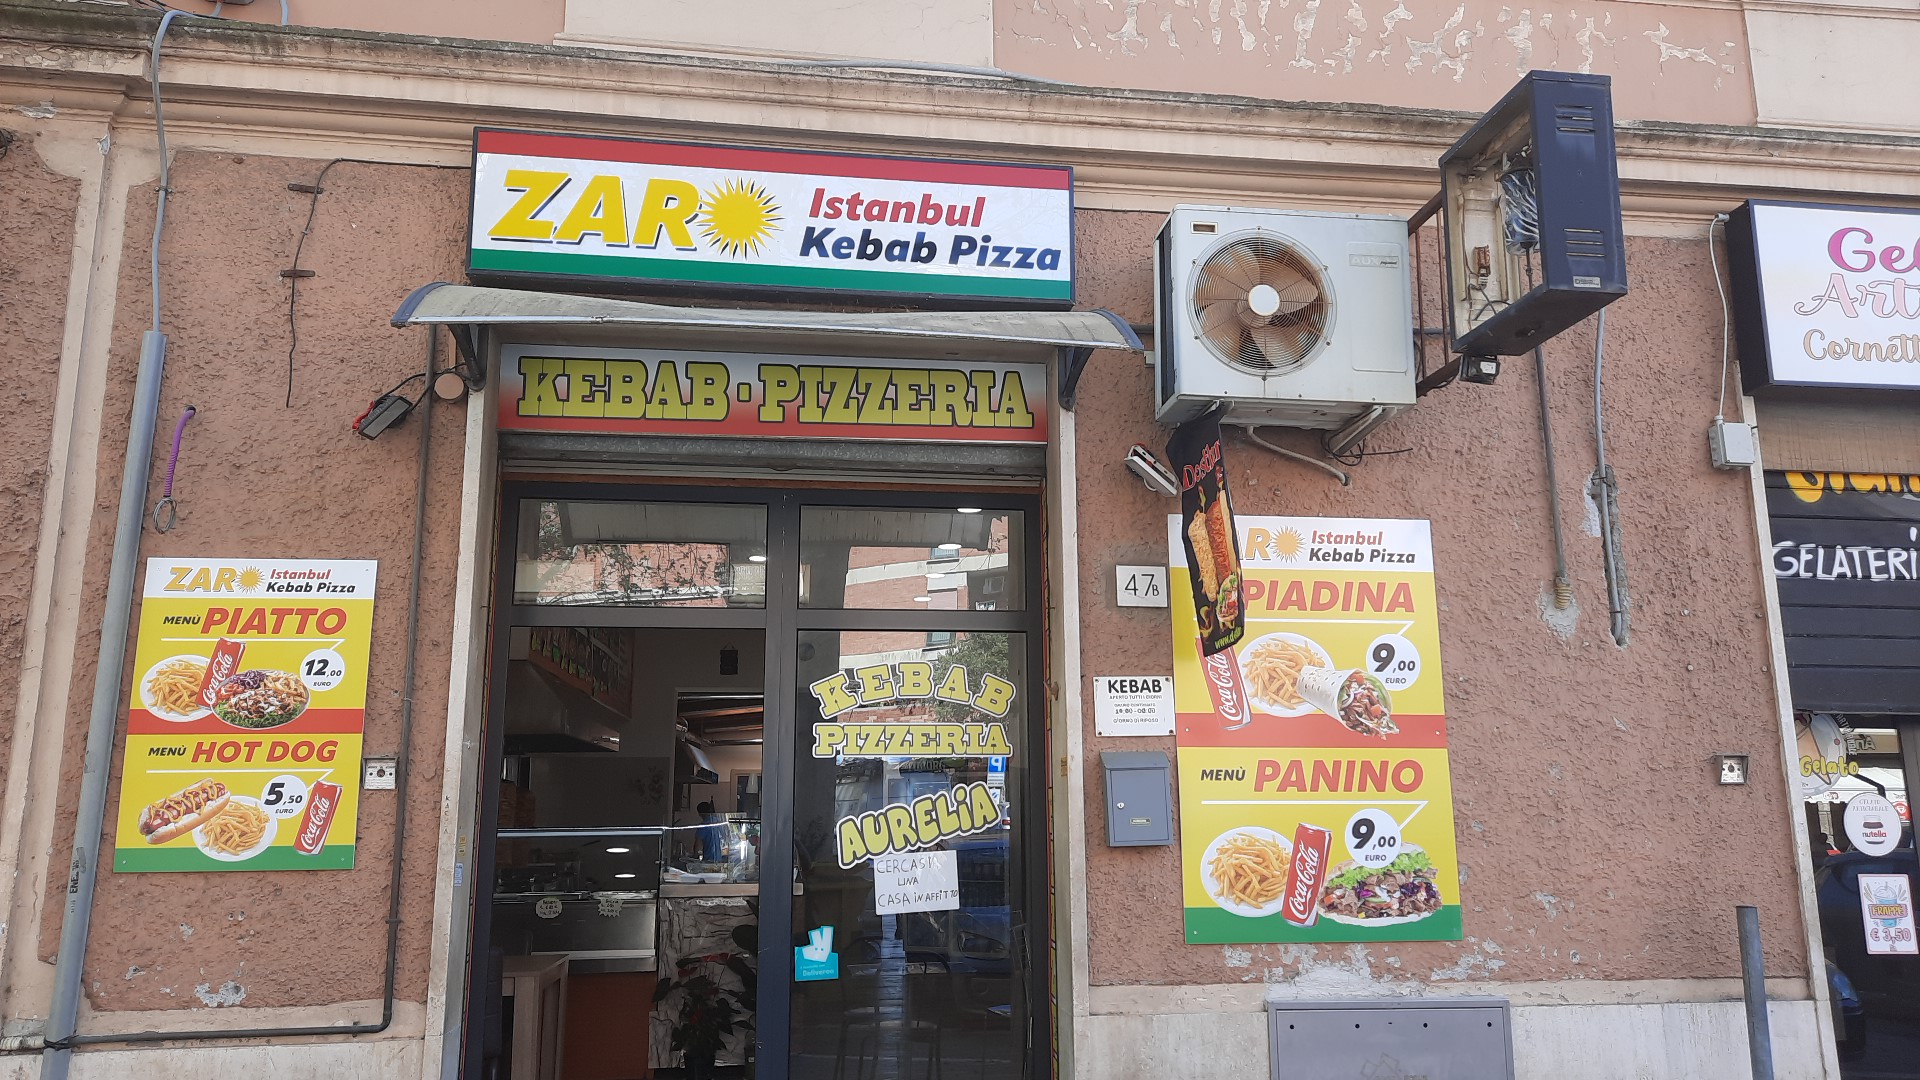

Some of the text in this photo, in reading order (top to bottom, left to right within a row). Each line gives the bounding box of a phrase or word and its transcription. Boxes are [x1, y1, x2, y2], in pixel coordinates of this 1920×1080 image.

[809, 188, 986, 227] Istanbul
[800, 226, 1062, 271] Kebab Pizza
[1794, 273, 1920, 319] Art
[517, 356, 1034, 429] KEBAB PIZZERIA
[1311, 530, 1383, 545] Istanbul
[1309, 548, 1416, 563] Kebab Pizza
[270, 569, 332, 580] Istanbul
[266, 581, 356, 594] Kebab Pizza
[1244, 579, 1415, 613] PIADINA
[163, 607, 347, 636] MENÙ PIATTO
[810, 662, 1016, 719] KEBAB
[1108, 679, 1162, 693] KEBAB
[812, 722, 1013, 758] PIZZERIA
[148, 740, 339, 763] MENÙ HOT DOG
[1200, 759, 1424, 793] MENÙ PANINO
[1800, 755, 1859, 777] Gelato
[1862, 829, 1887, 838] nutella
[1365, 854, 1387, 862] EURO
[898, 876, 919, 886] UNA
[878, 893, 911, 907] CASA
[1870, 928, 1880, 941] €
